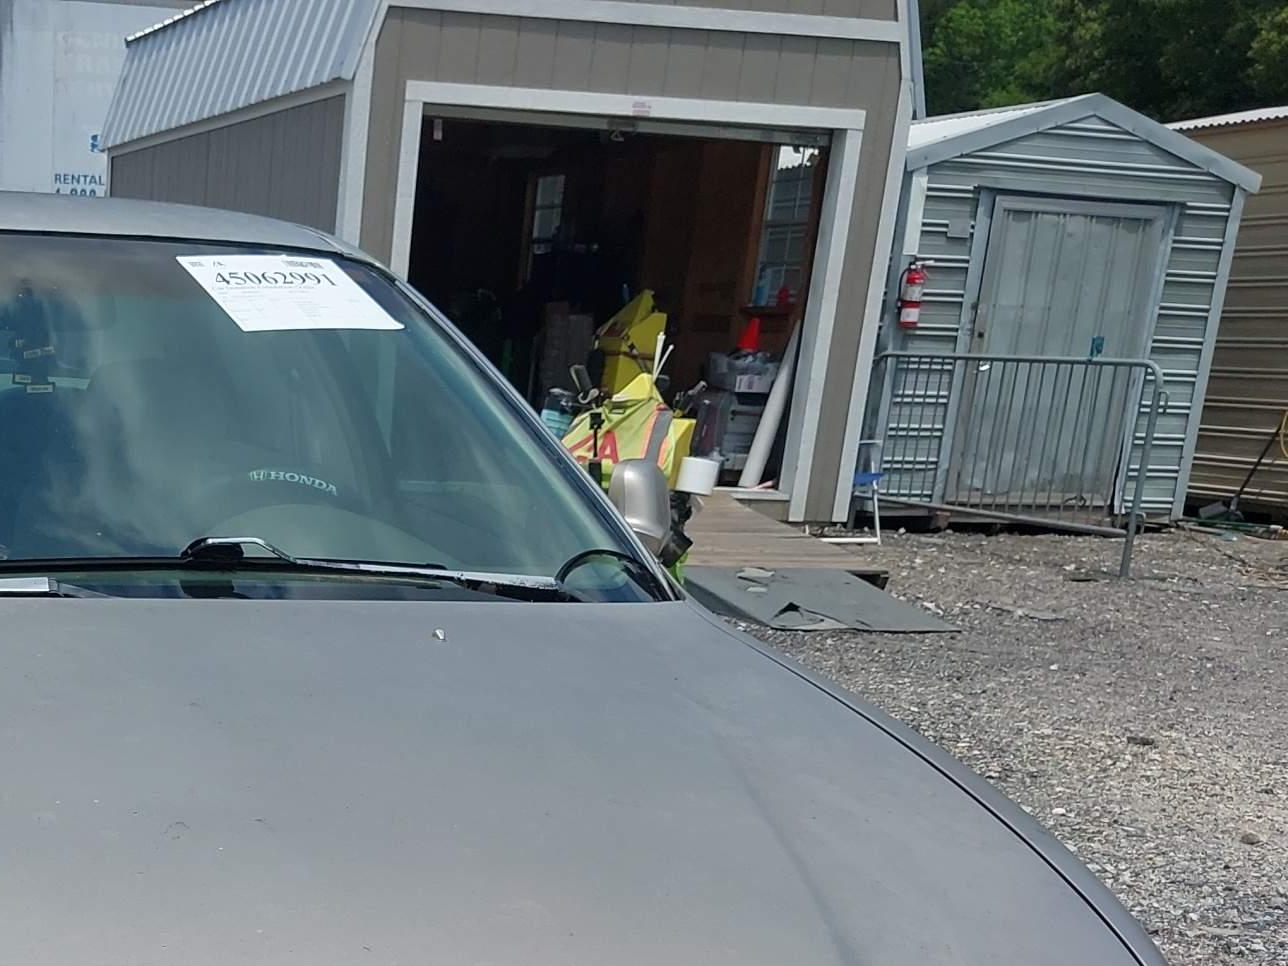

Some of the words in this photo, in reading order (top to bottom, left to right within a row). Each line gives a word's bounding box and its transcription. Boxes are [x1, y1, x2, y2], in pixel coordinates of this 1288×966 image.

[54, 173, 105, 186] RENTAL
[215, 270, 339, 287] 45062991
[269, 471, 338, 496] HONDA
